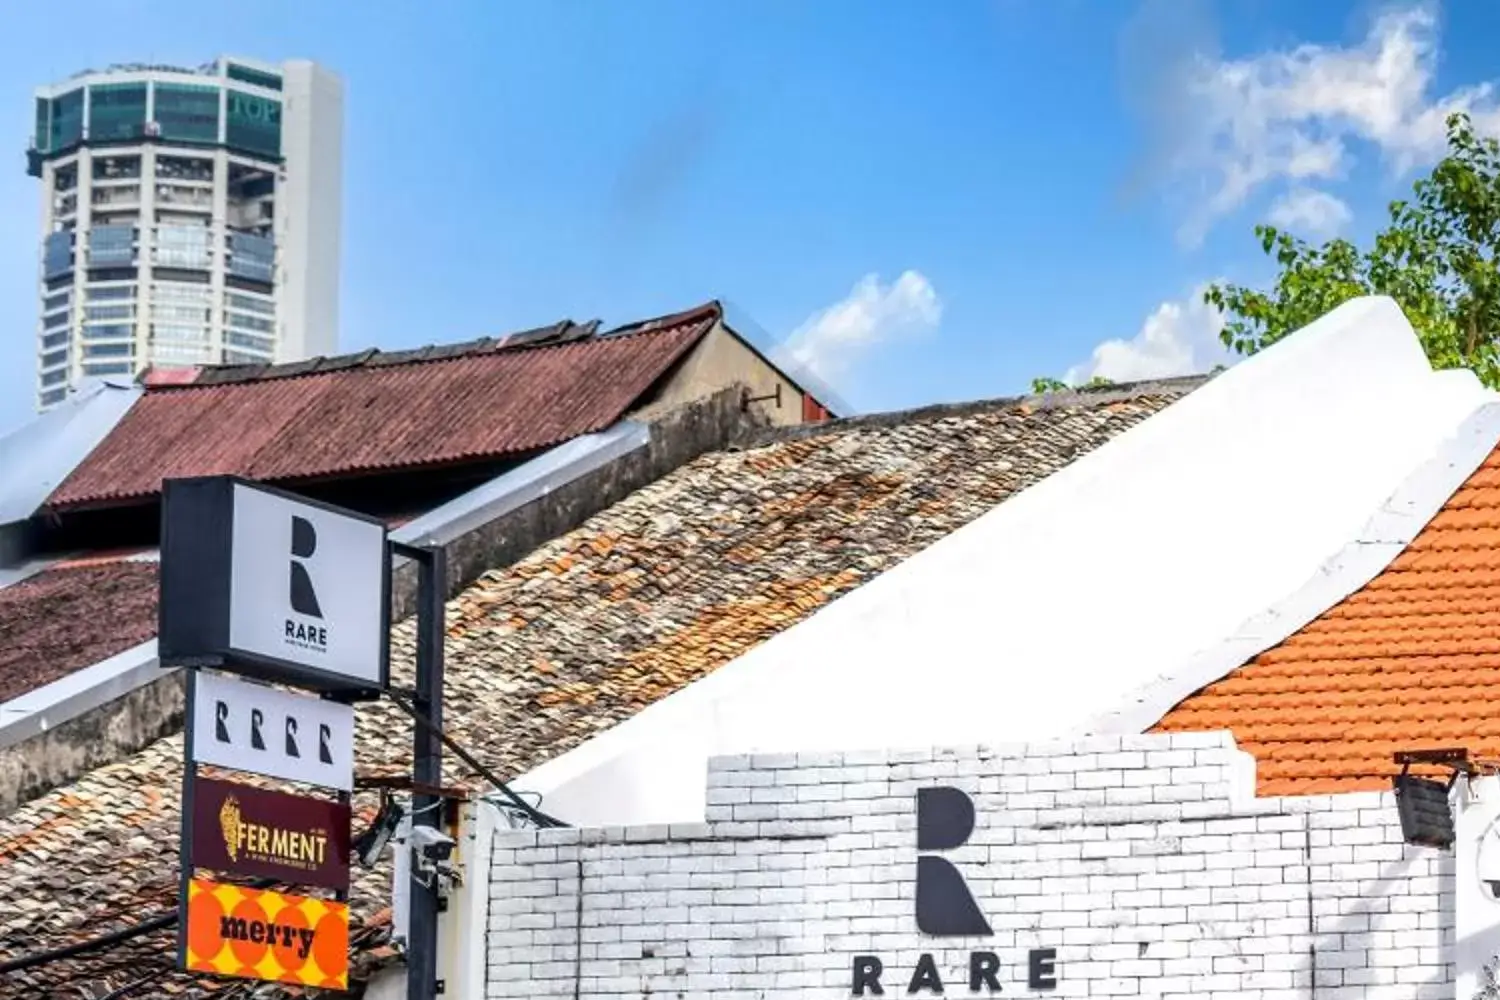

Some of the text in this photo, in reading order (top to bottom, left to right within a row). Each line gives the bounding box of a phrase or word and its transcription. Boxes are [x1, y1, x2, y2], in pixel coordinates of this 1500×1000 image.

[285, 619, 327, 645] RARE
[237, 823, 327, 864] FERMENT
[220, 916, 315, 960] merry
[852, 948, 1057, 996] RARE
